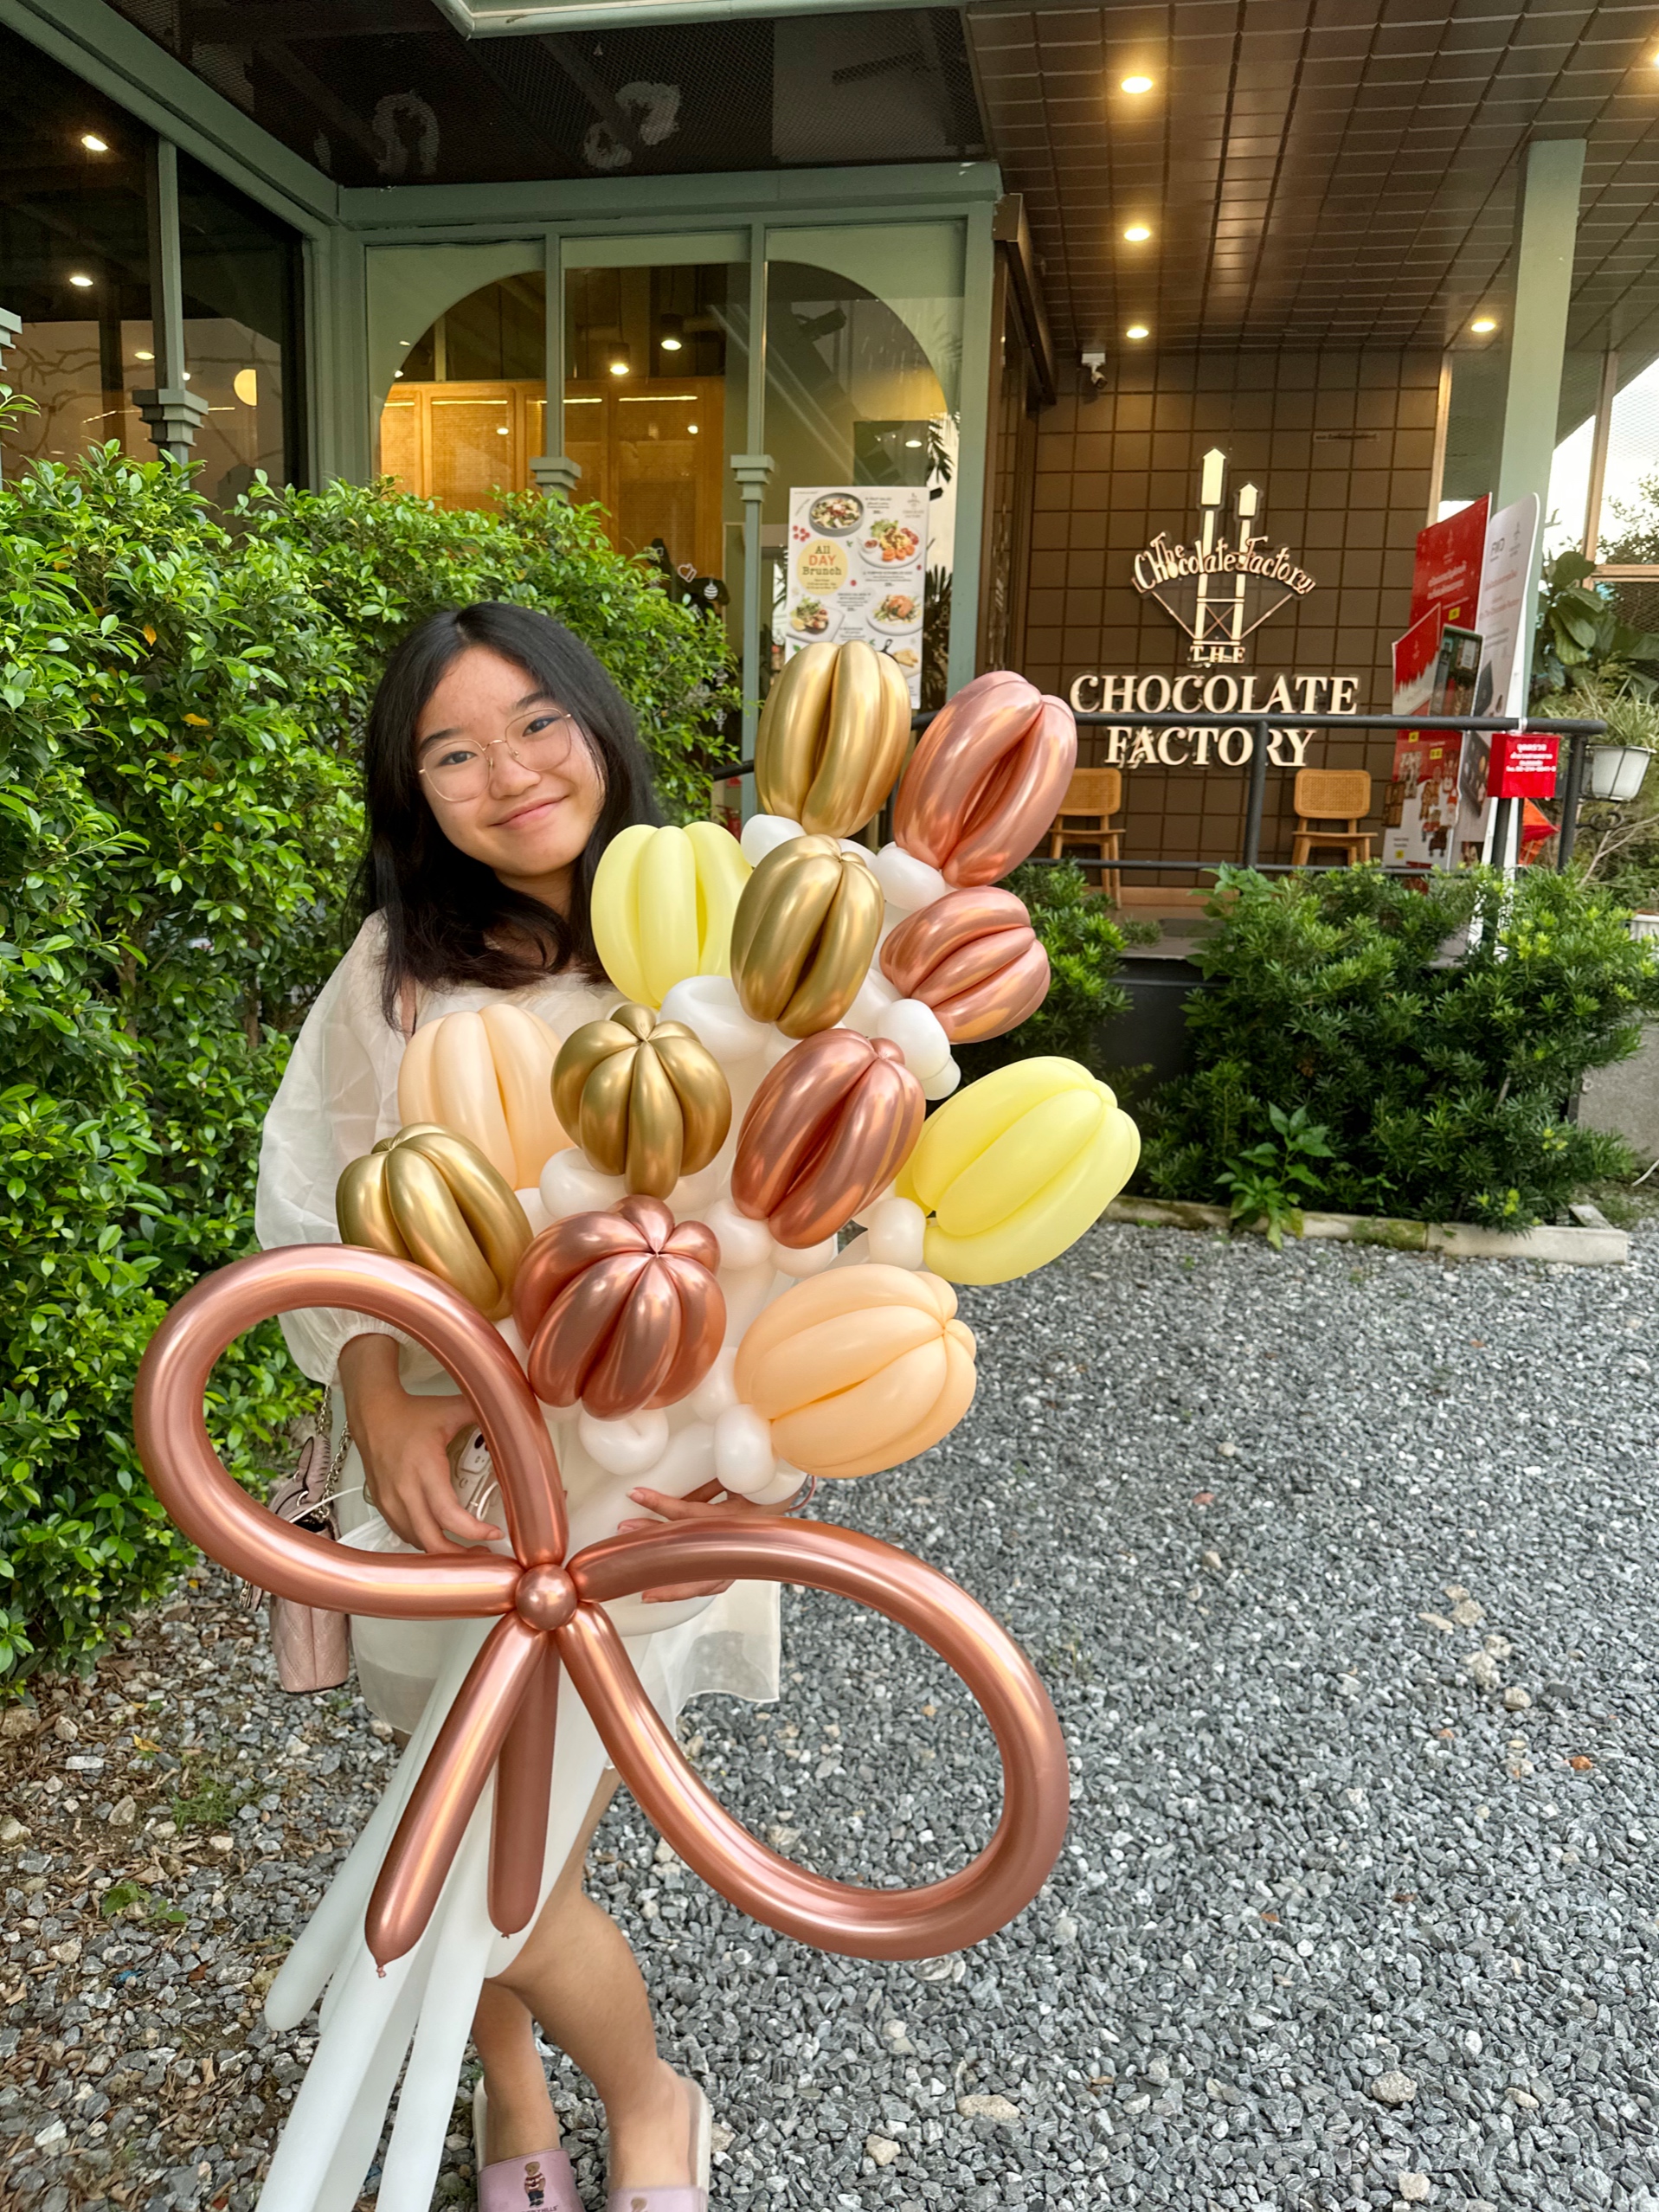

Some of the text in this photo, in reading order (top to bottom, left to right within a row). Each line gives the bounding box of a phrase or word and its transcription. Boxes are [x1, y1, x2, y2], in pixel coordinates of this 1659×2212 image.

[814, 545, 831, 555] All
[1150, 531, 1185, 564] The
[802, 566, 842, 576] Brunch
[808, 555, 837, 566] DAY
[1231, 536, 1313, 595] Factory
[1189, 646, 1246, 664] THE
[1069, 673, 1360, 716] CHOCOLATE
[1103, 726, 1317, 768] FACTORY
